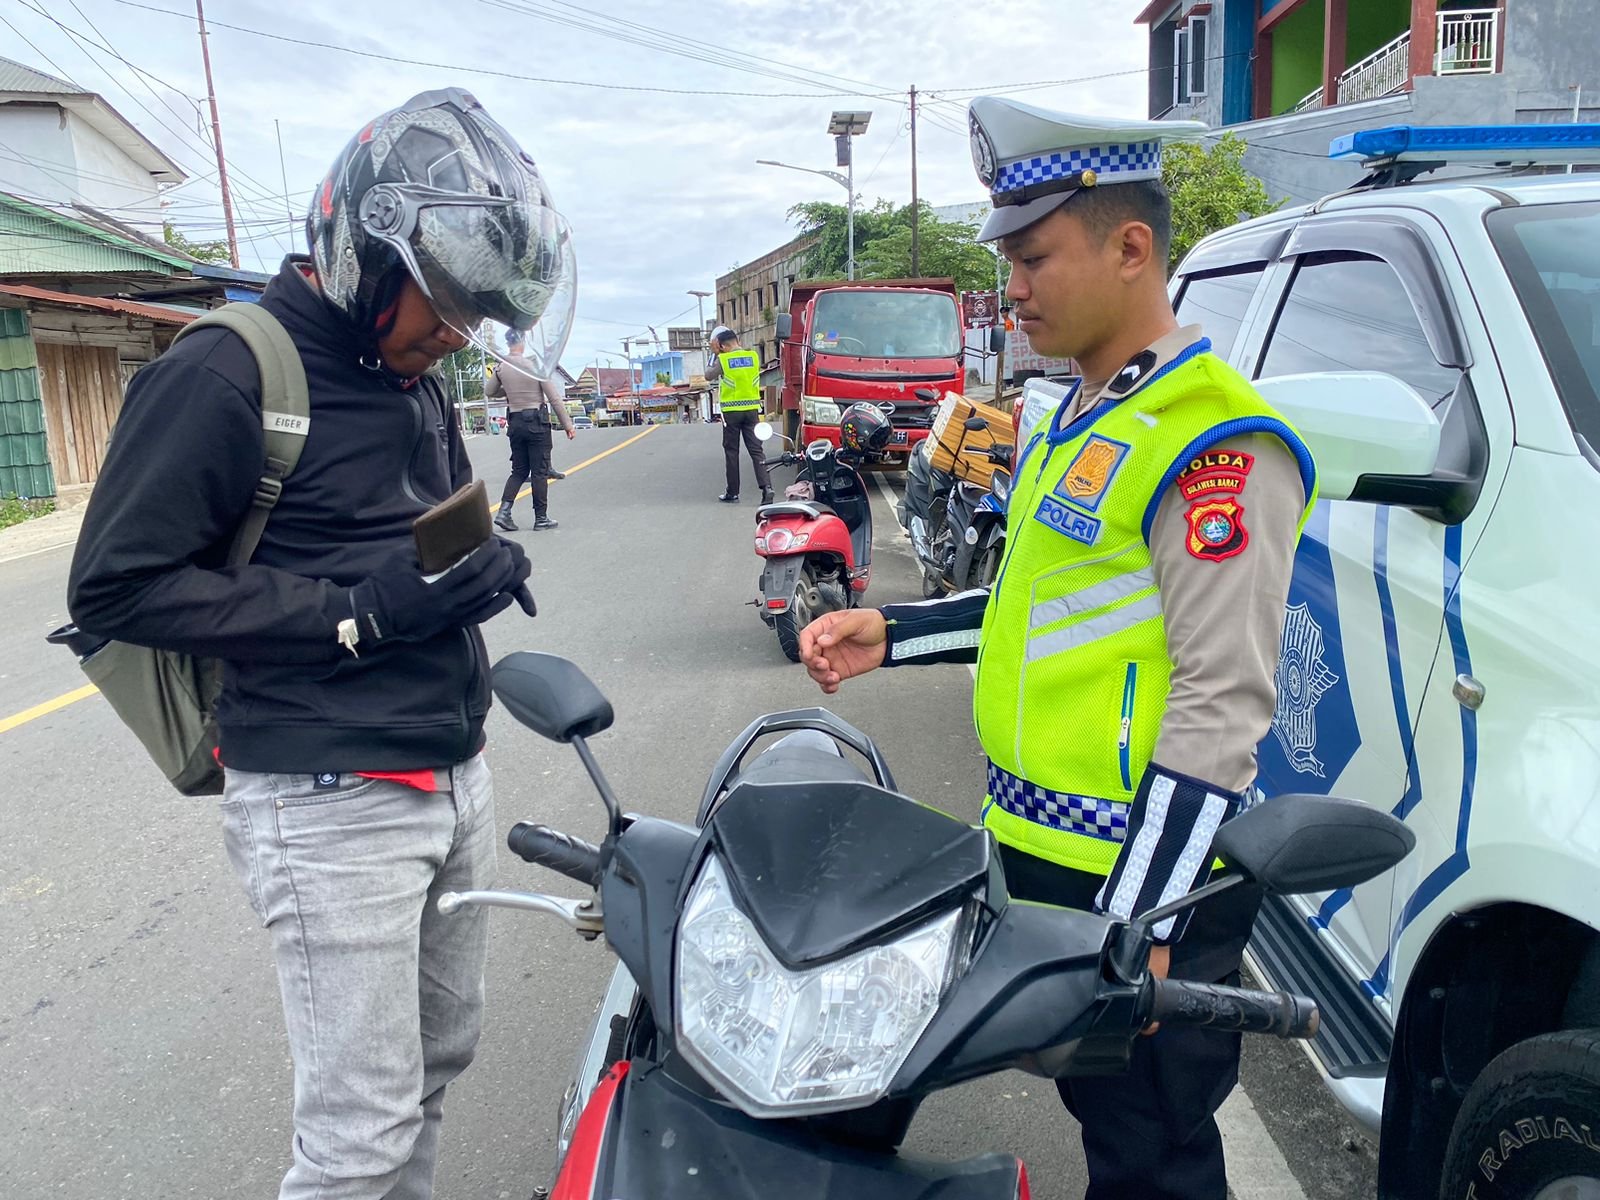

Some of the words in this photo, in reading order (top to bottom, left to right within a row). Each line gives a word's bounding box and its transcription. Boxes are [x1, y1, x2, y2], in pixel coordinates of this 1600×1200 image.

[275, 417, 302, 429] EIGER
[1187, 479, 1216, 494] SULAWESI
[1217, 478, 1239, 488] BARAT
[1039, 502, 1095, 539] POLRI
[1479, 1116, 1600, 1182] RADIAL
